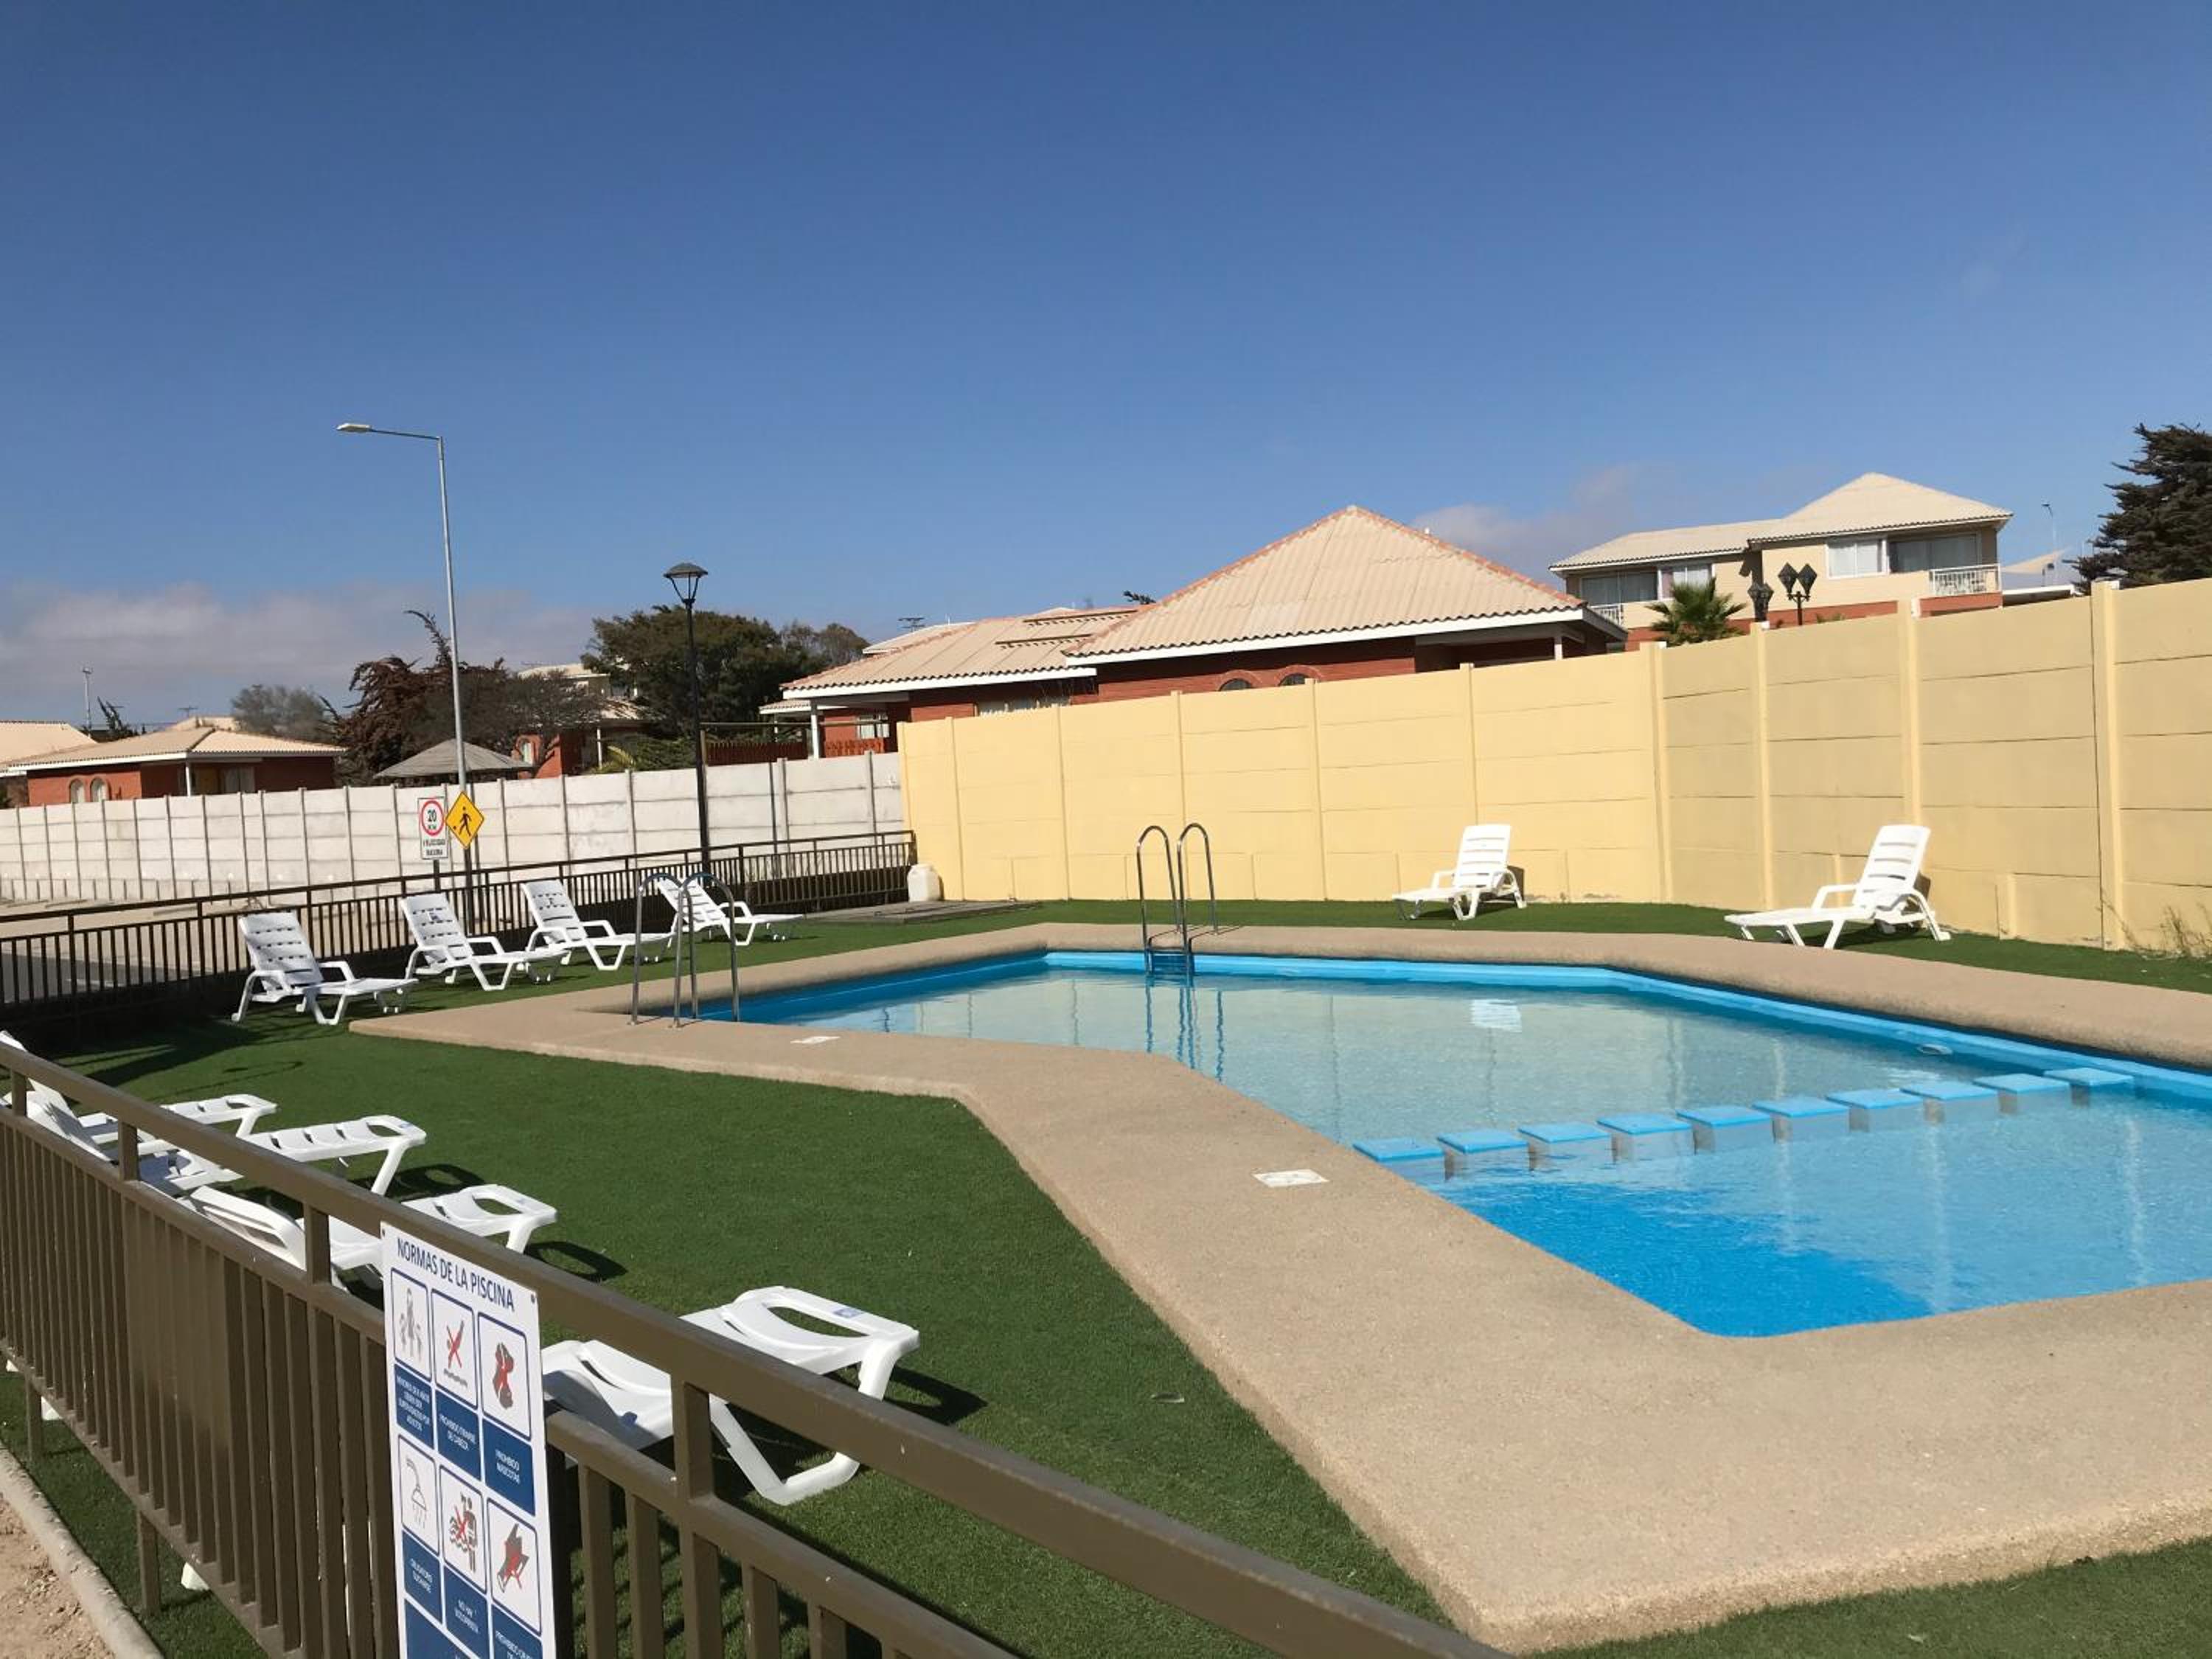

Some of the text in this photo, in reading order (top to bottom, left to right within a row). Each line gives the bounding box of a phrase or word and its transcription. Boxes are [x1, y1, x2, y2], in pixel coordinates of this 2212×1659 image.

[427, 809, 437, 822] 20
[397, 1238, 515, 1312] NORMAS DE LA PISCINA
